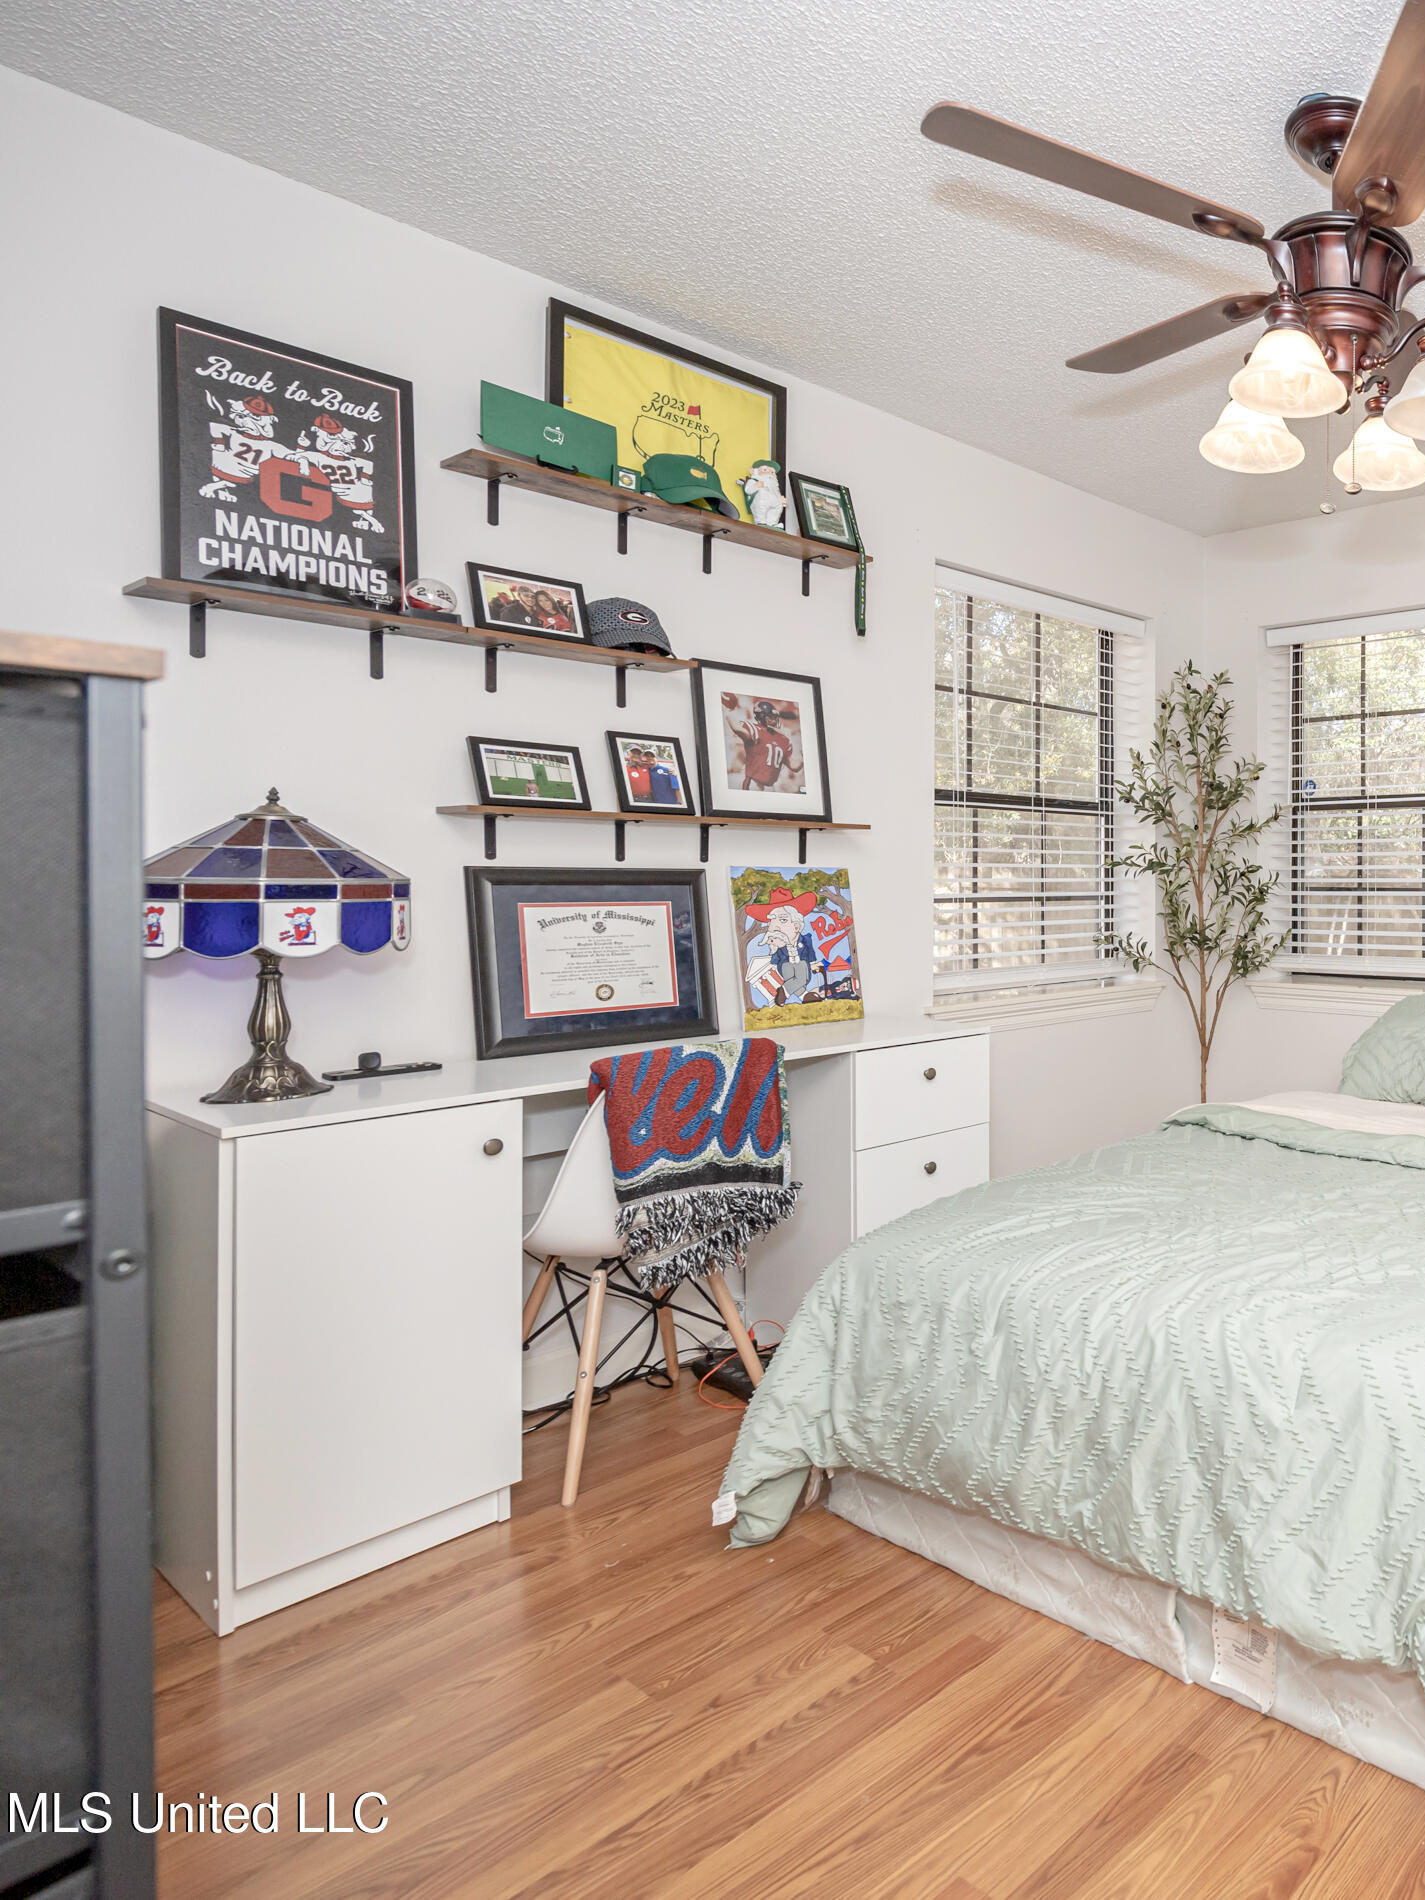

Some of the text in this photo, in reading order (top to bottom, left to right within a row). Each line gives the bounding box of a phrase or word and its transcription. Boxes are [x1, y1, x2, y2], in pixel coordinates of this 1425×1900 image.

[195, 356, 382, 423] Back to Back
[652, 392, 685, 411] 2023
[641, 402, 710, 434] MASTERS
[234, 442, 264, 465] 21
[320, 464, 355, 484] 22
[215, 509, 373, 564] NATIONAL
[198, 537, 387, 596] CHAMPIONS
[765, 743, 784, 769] 10
[537, 910, 656, 931] University of Mississippi
